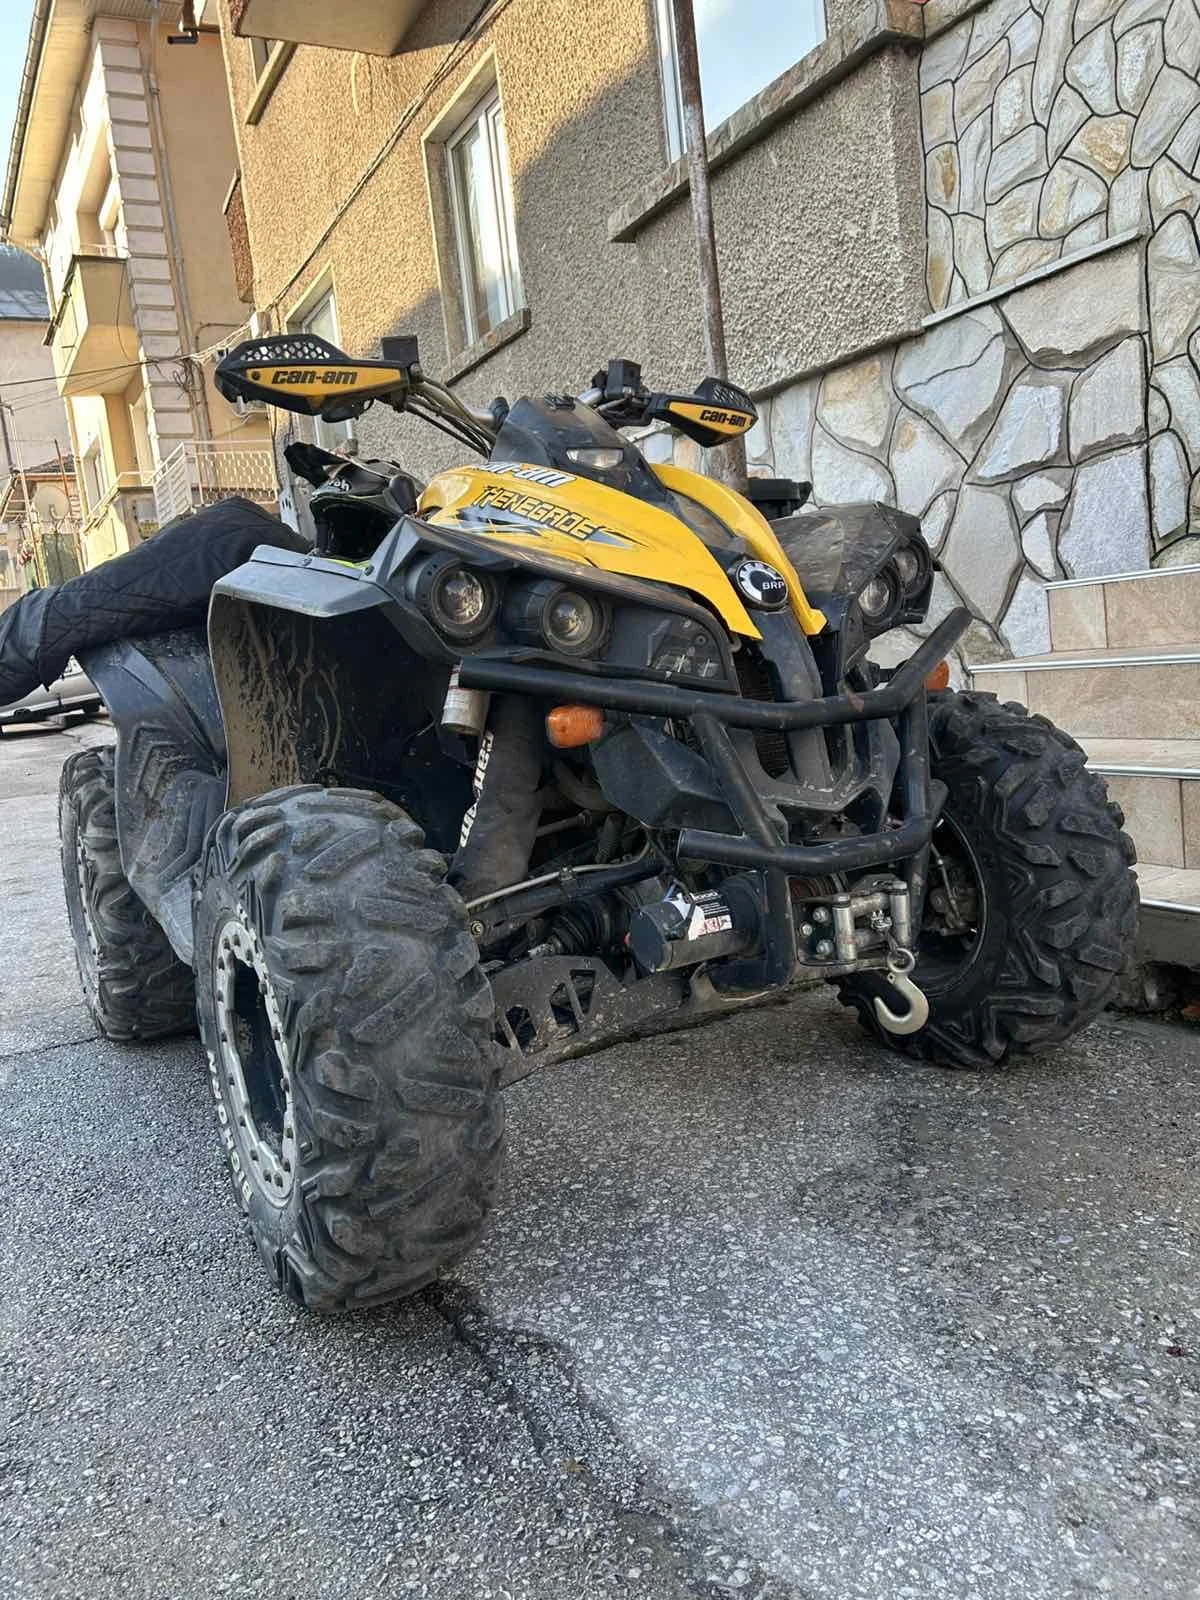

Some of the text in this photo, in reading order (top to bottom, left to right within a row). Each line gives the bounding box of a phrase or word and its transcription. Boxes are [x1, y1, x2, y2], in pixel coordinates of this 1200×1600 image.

[272, 370, 358, 384] can-am
[700, 409, 747, 427] can-am
[473, 485, 599, 541] RENEGADE
[762, 581, 785, 590] BRP
[207, 1050, 252, 1201] BIGHORN
